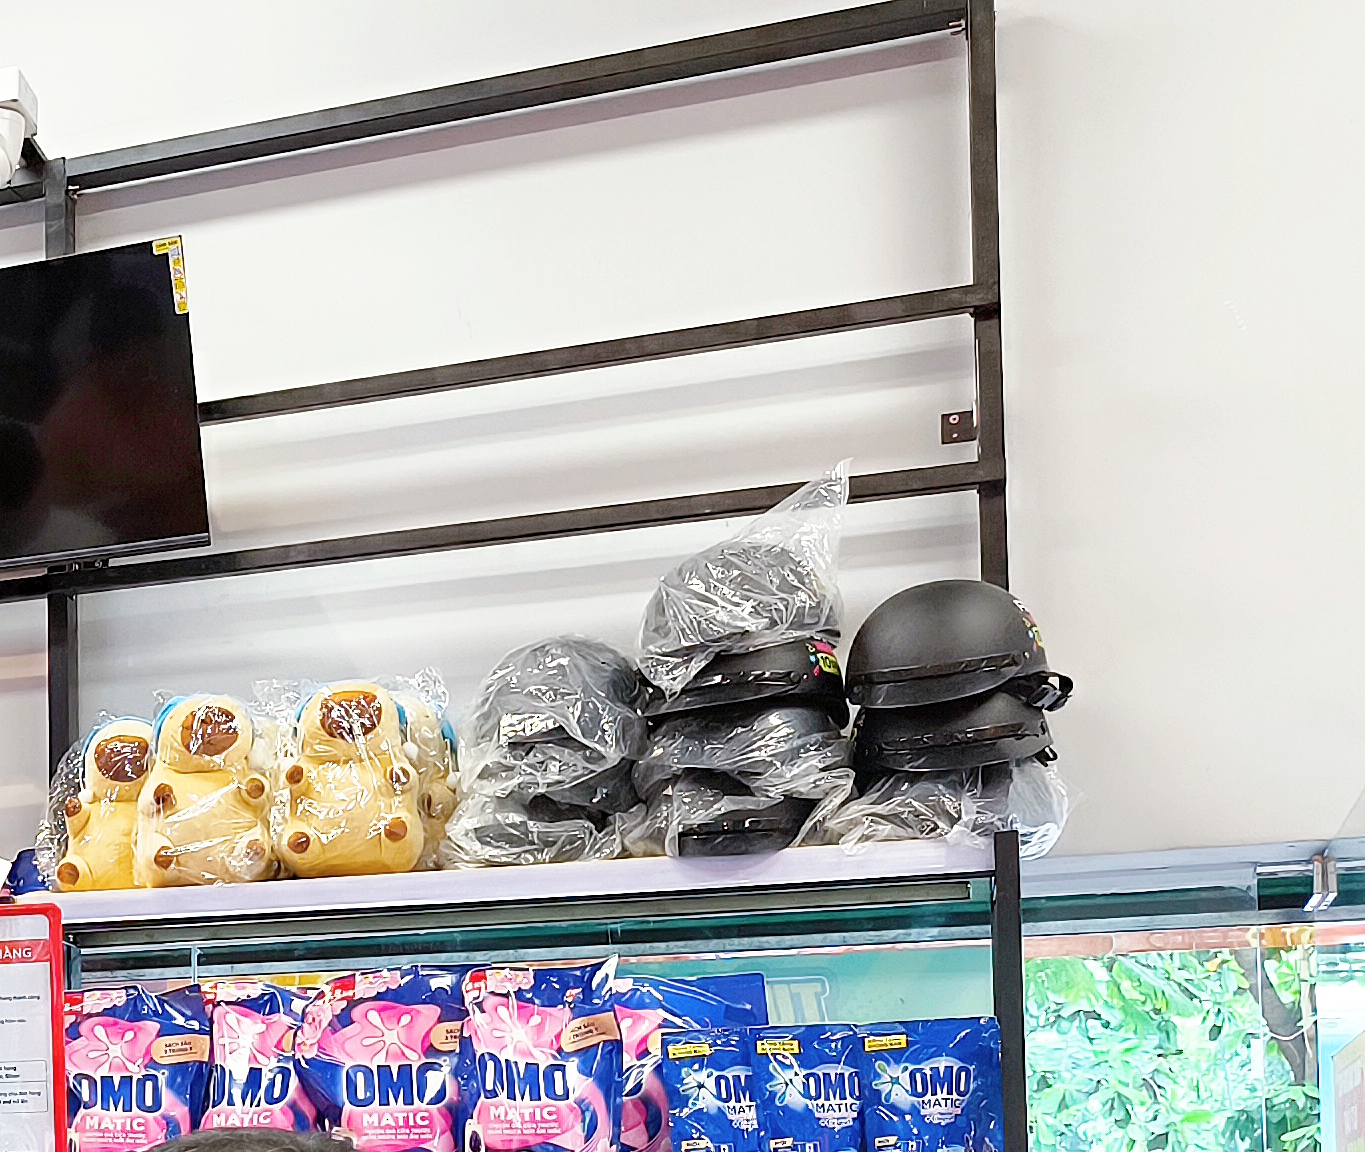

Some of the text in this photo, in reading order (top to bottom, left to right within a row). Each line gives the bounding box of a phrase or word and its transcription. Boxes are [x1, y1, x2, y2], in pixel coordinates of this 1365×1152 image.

[72, 1072, 163, 1132] OMO MATIC
[345, 1062, 448, 1127] OMO MATIC
[477, 1052, 570, 1124] OMO MATIC
[715, 1074, 755, 1116] OM MAT
[803, 1070, 861, 1114] OMO MATIC
[909, 1065, 971, 1110] OMO MATIC
[212, 1111, 272, 1127] MATIC
